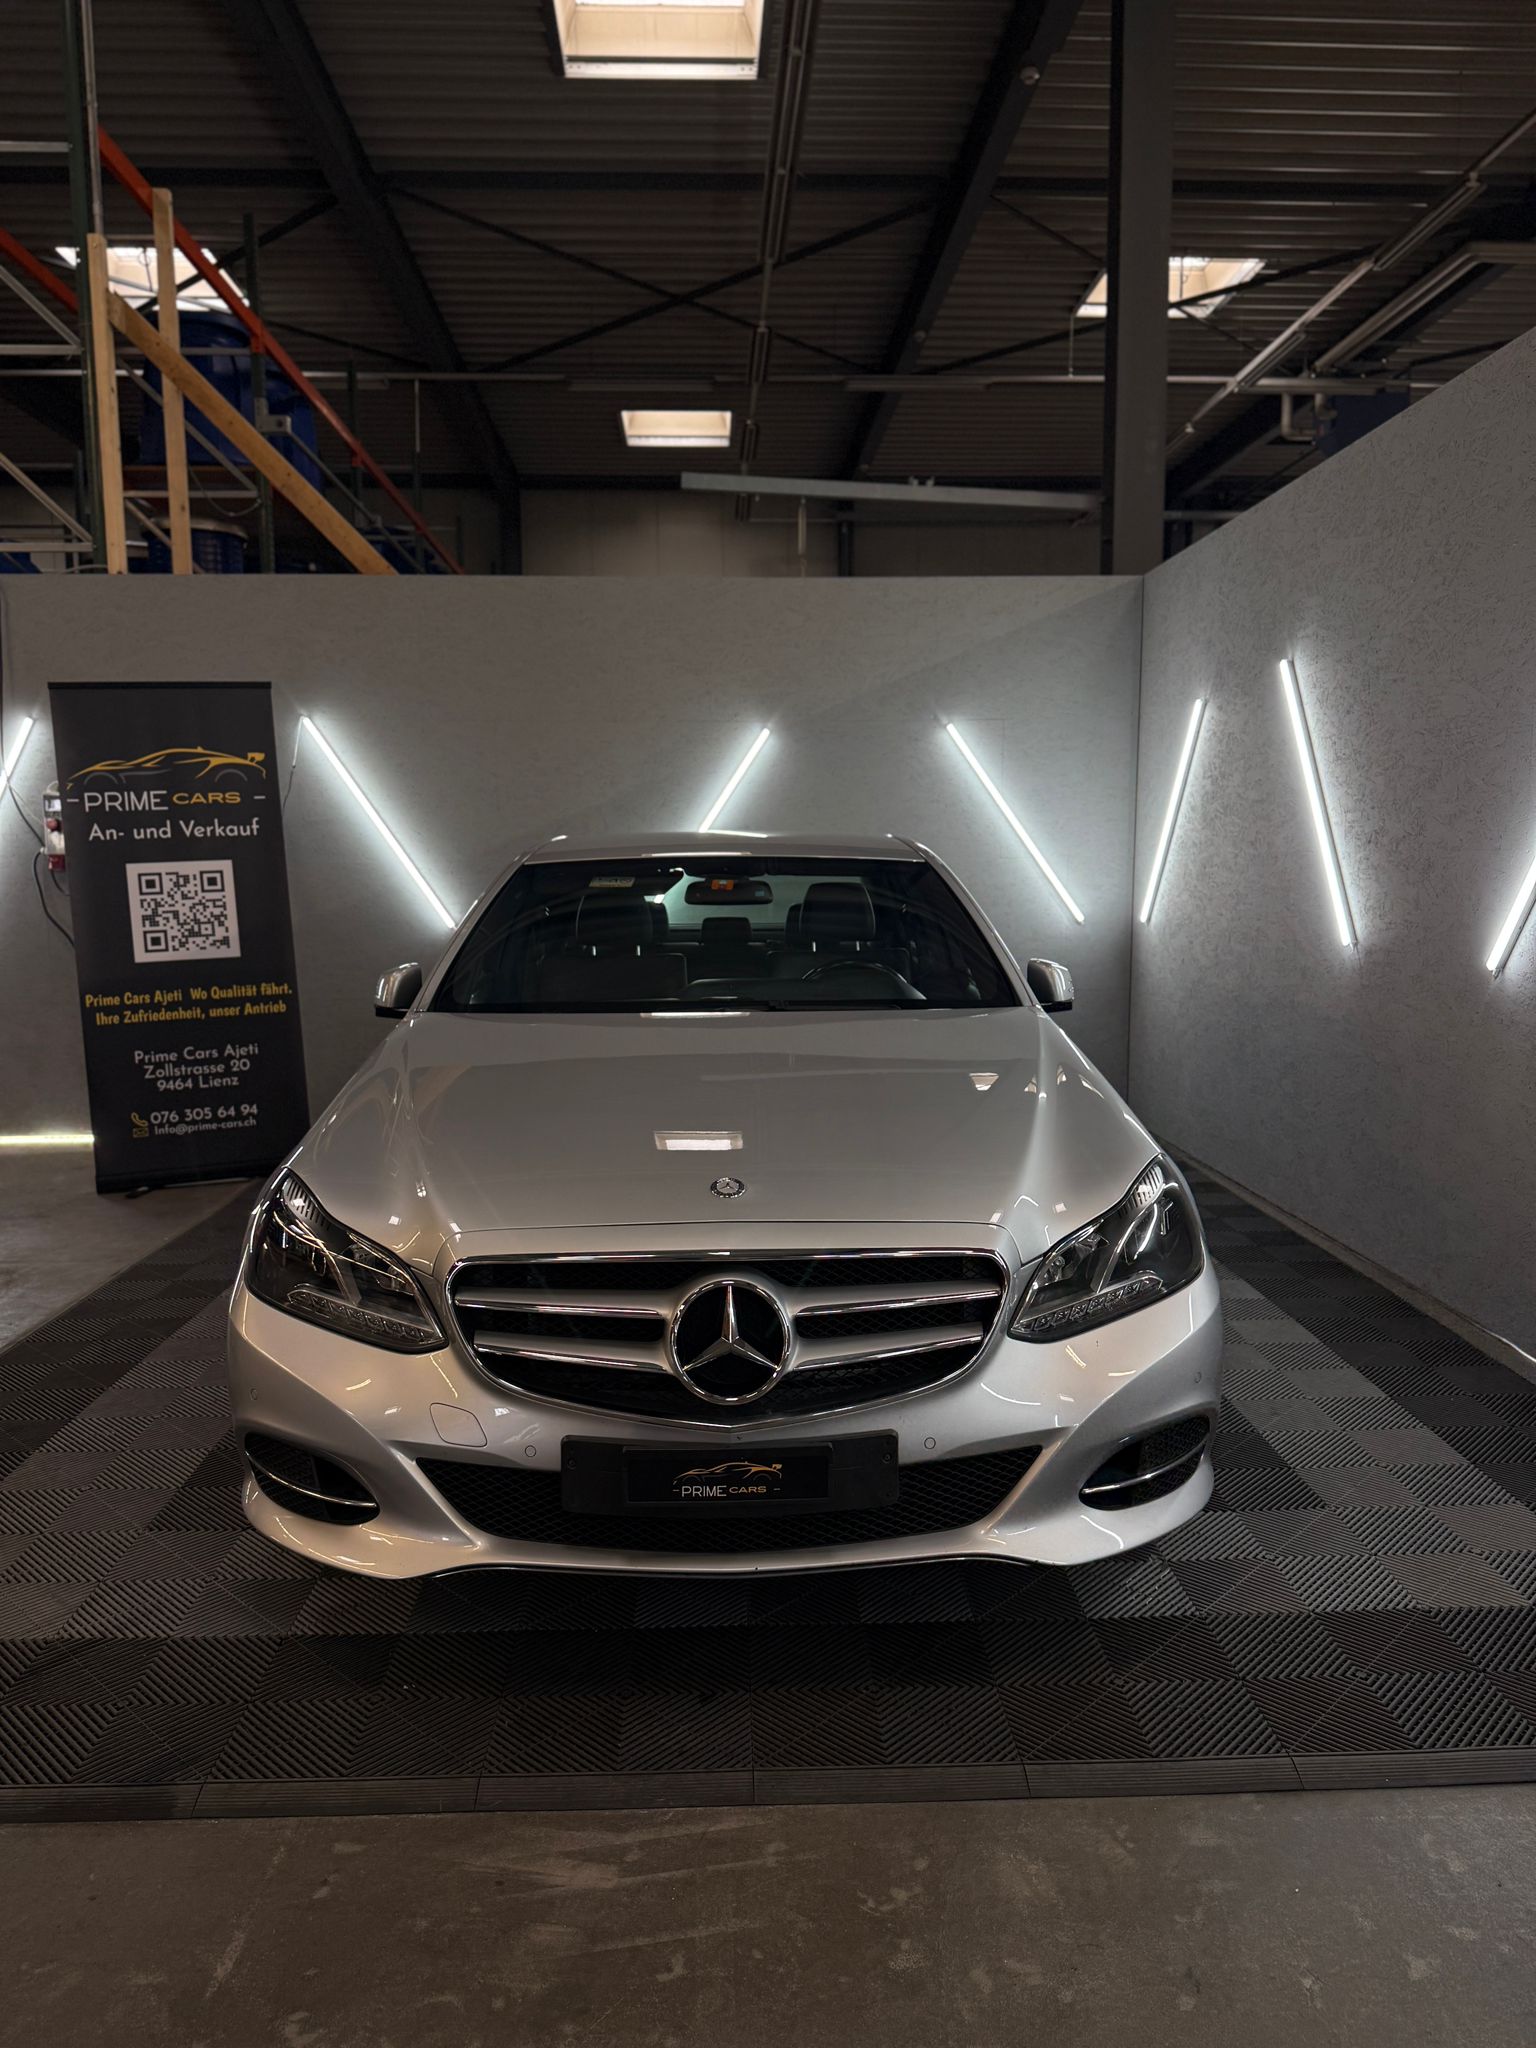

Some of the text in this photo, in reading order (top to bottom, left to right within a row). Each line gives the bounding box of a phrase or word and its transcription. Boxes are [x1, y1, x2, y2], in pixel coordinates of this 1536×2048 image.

[84, 790, 241, 812] PRIME CARS
[88, 817, 260, 841] An- und Verkauf
[85, 982, 292, 1008] Prime Cars Ajeti Wo Qualität fährt.
[96, 1000, 286, 1026] Ihre Zufriedenheit, unser Antrieb
[134, 1043, 259, 1064] Prime Cars Ajeti
[143, 1058, 250, 1079] Zollstrasse 20
[157, 1075, 240, 1092] 9464 Lienz
[150, 1103, 258, 1124] 076 305 64 94
[681, 1485, 767, 1497] PRIME CARS
